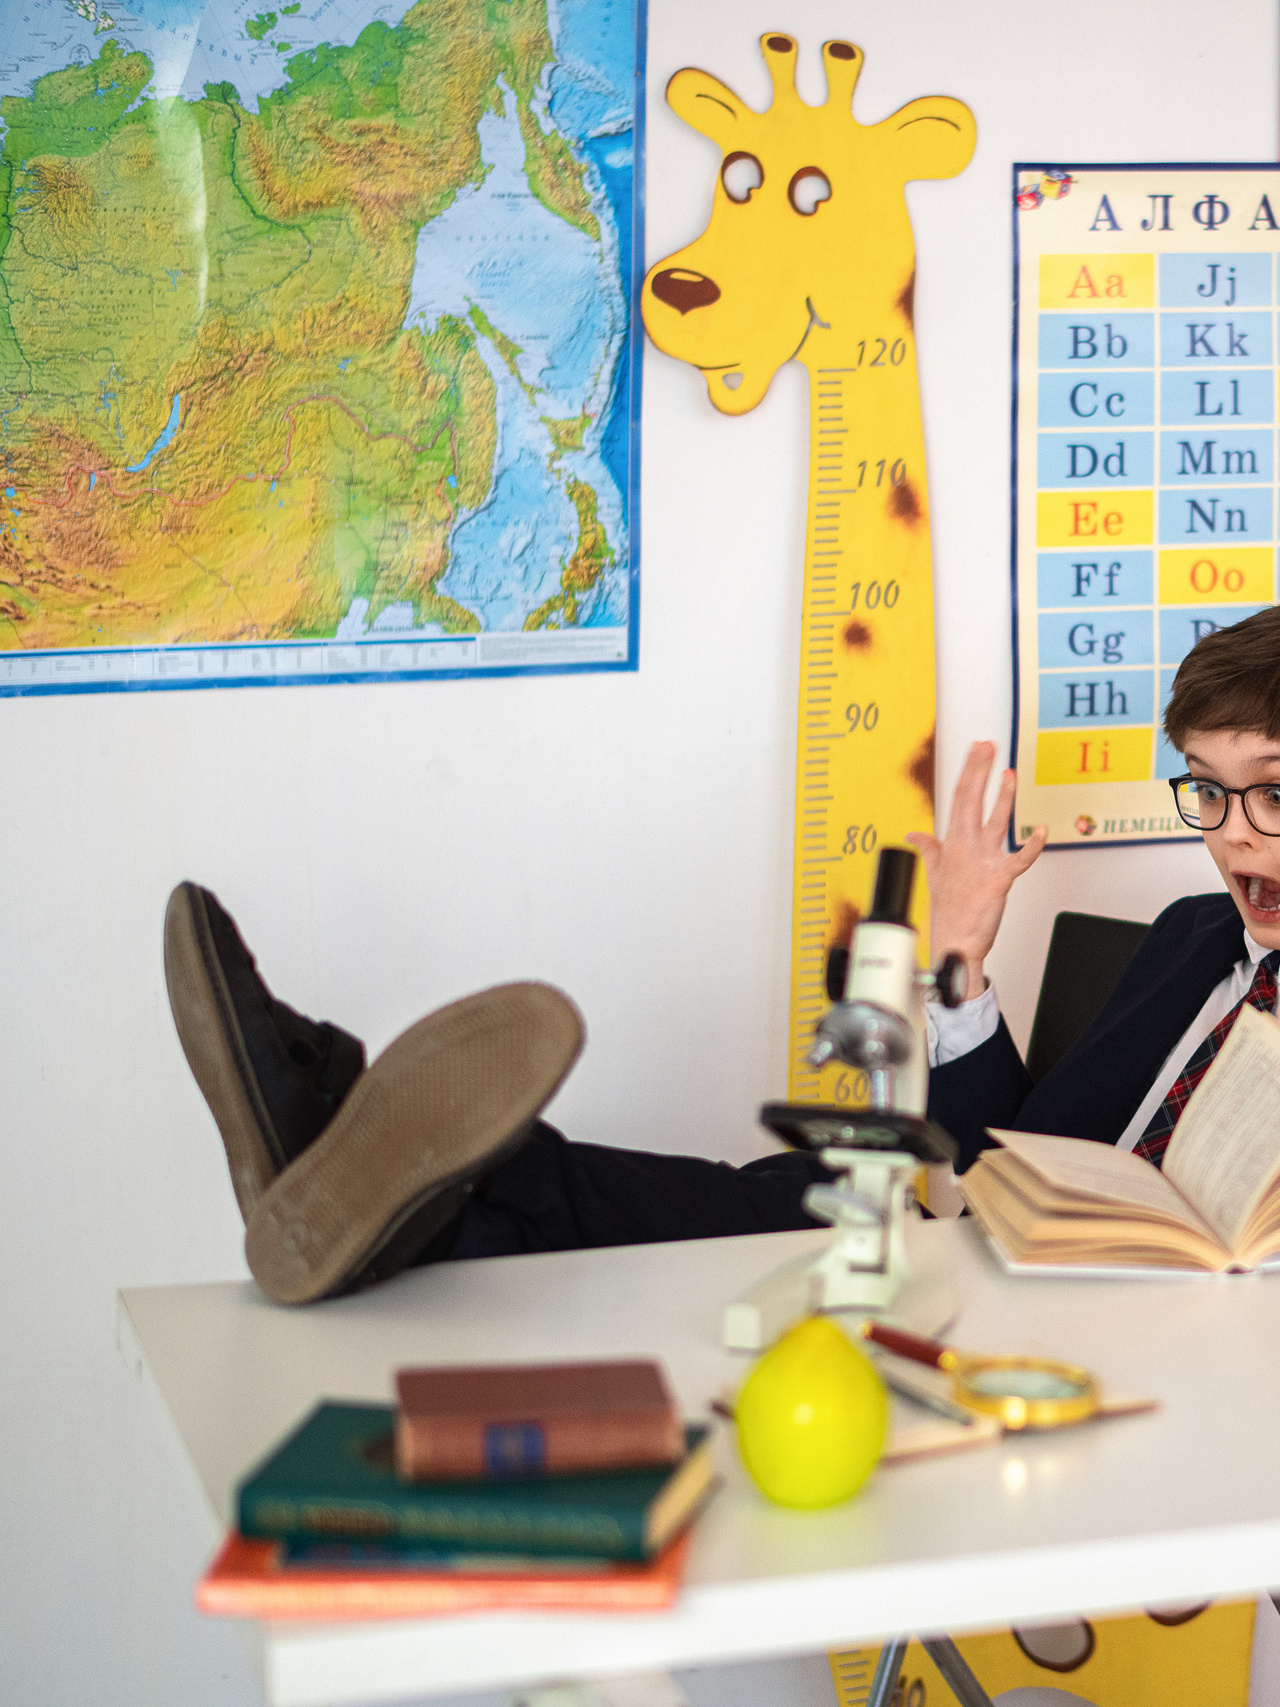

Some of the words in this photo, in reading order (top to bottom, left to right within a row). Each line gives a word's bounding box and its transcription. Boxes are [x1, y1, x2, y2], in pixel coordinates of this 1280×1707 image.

[1067, 264, 1125, 299] Aa
[1196, 263, 1237, 307] Jj
[857, 337, 907, 368] 120
[1068, 323, 1129, 360] Bb
[1186, 322, 1249, 358] Kk
[1068, 382, 1125, 418] Cc
[1195, 379, 1241, 417] Ll
[858, 458, 906, 489] 110
[1067, 441, 1126, 479] Dd
[1177, 440, 1258, 476] Mm
[1070, 501, 1124, 537] Ee
[1186, 498, 1247, 534] Nn
[1072, 561, 1122, 598] Ff
[1188, 559, 1246, 593] Oo
[850, 579, 900, 611] 100
[1067, 622, 1126, 665] Gg
[1065, 680, 1128, 718] Hh
[845, 702, 880, 733] 90
[1077, 741, 1110, 774] Ii
[842, 826, 878, 857] 80
[1102, 814, 1194, 835] НЕМЕЦК
[833, 1071, 869, 1102] 60
